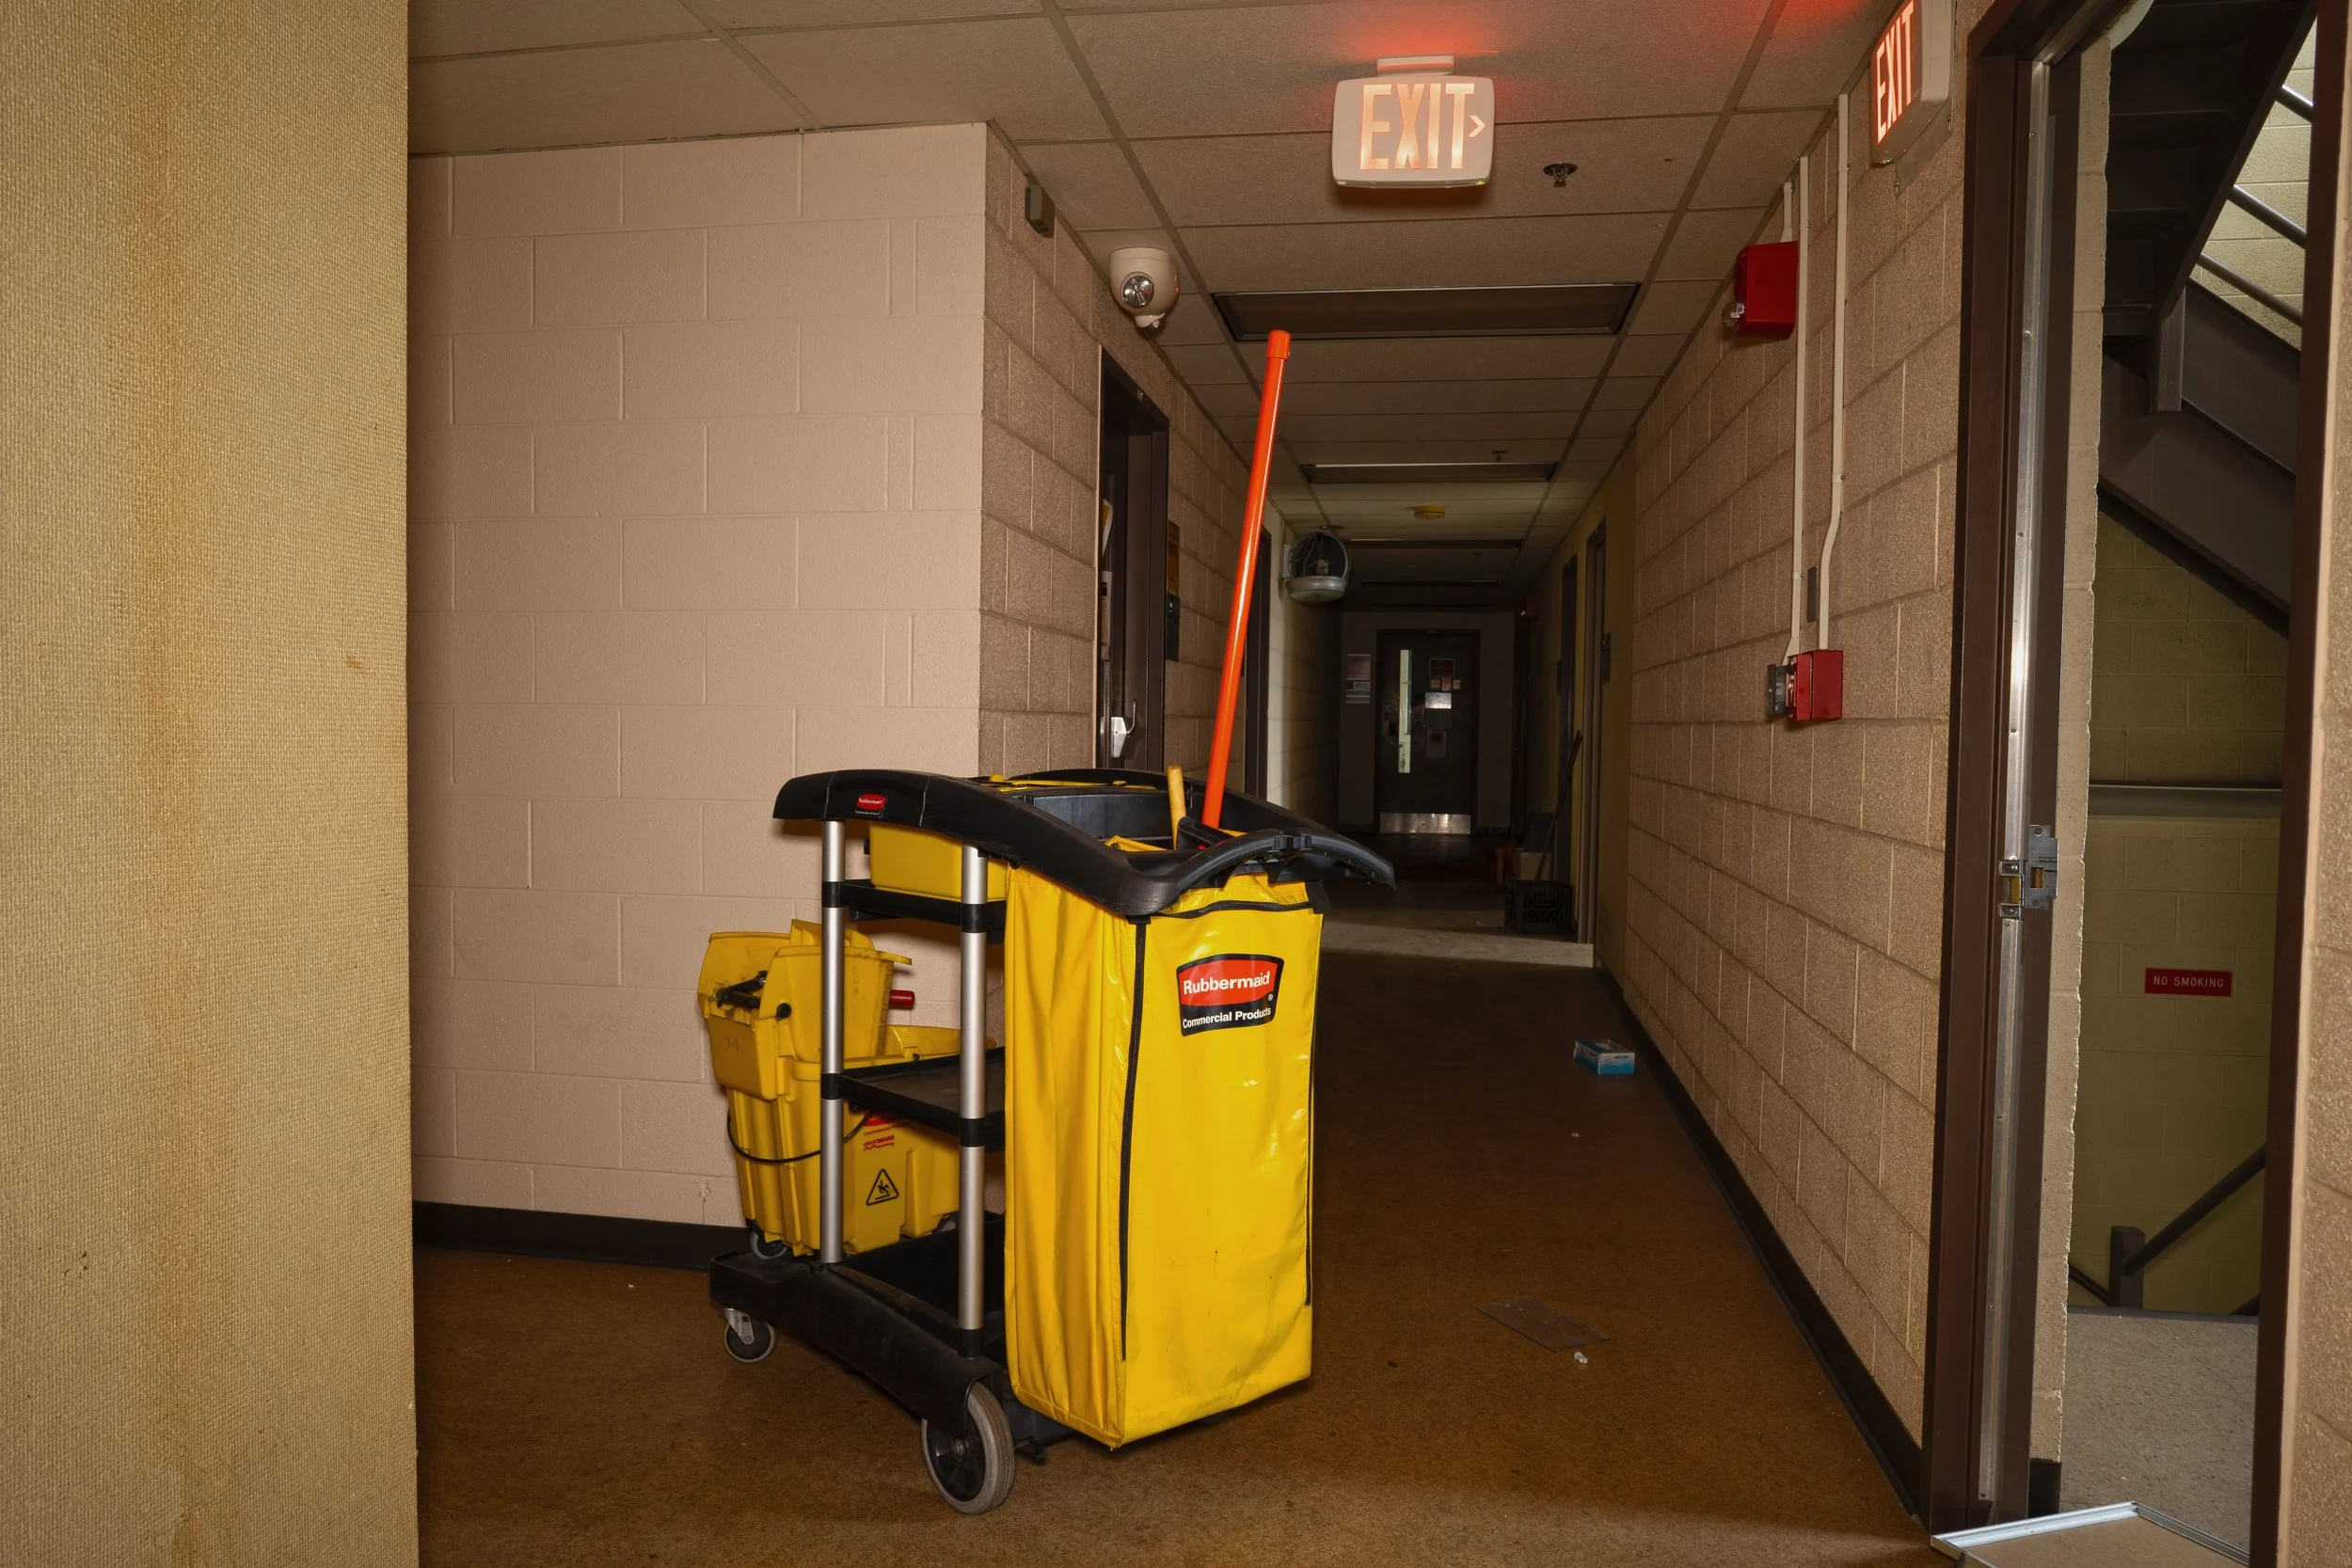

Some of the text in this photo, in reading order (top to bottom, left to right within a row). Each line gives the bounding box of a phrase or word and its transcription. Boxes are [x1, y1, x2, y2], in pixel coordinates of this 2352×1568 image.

[1877, 0, 1915, 145] EXIT
[1360, 83, 1475, 170] EXIT
[1184, 971, 1271, 995] Rubbermaid
[2153, 975, 2224, 988] NO SMOKING
[1183, 1006, 1272, 1029] Commercial Products
